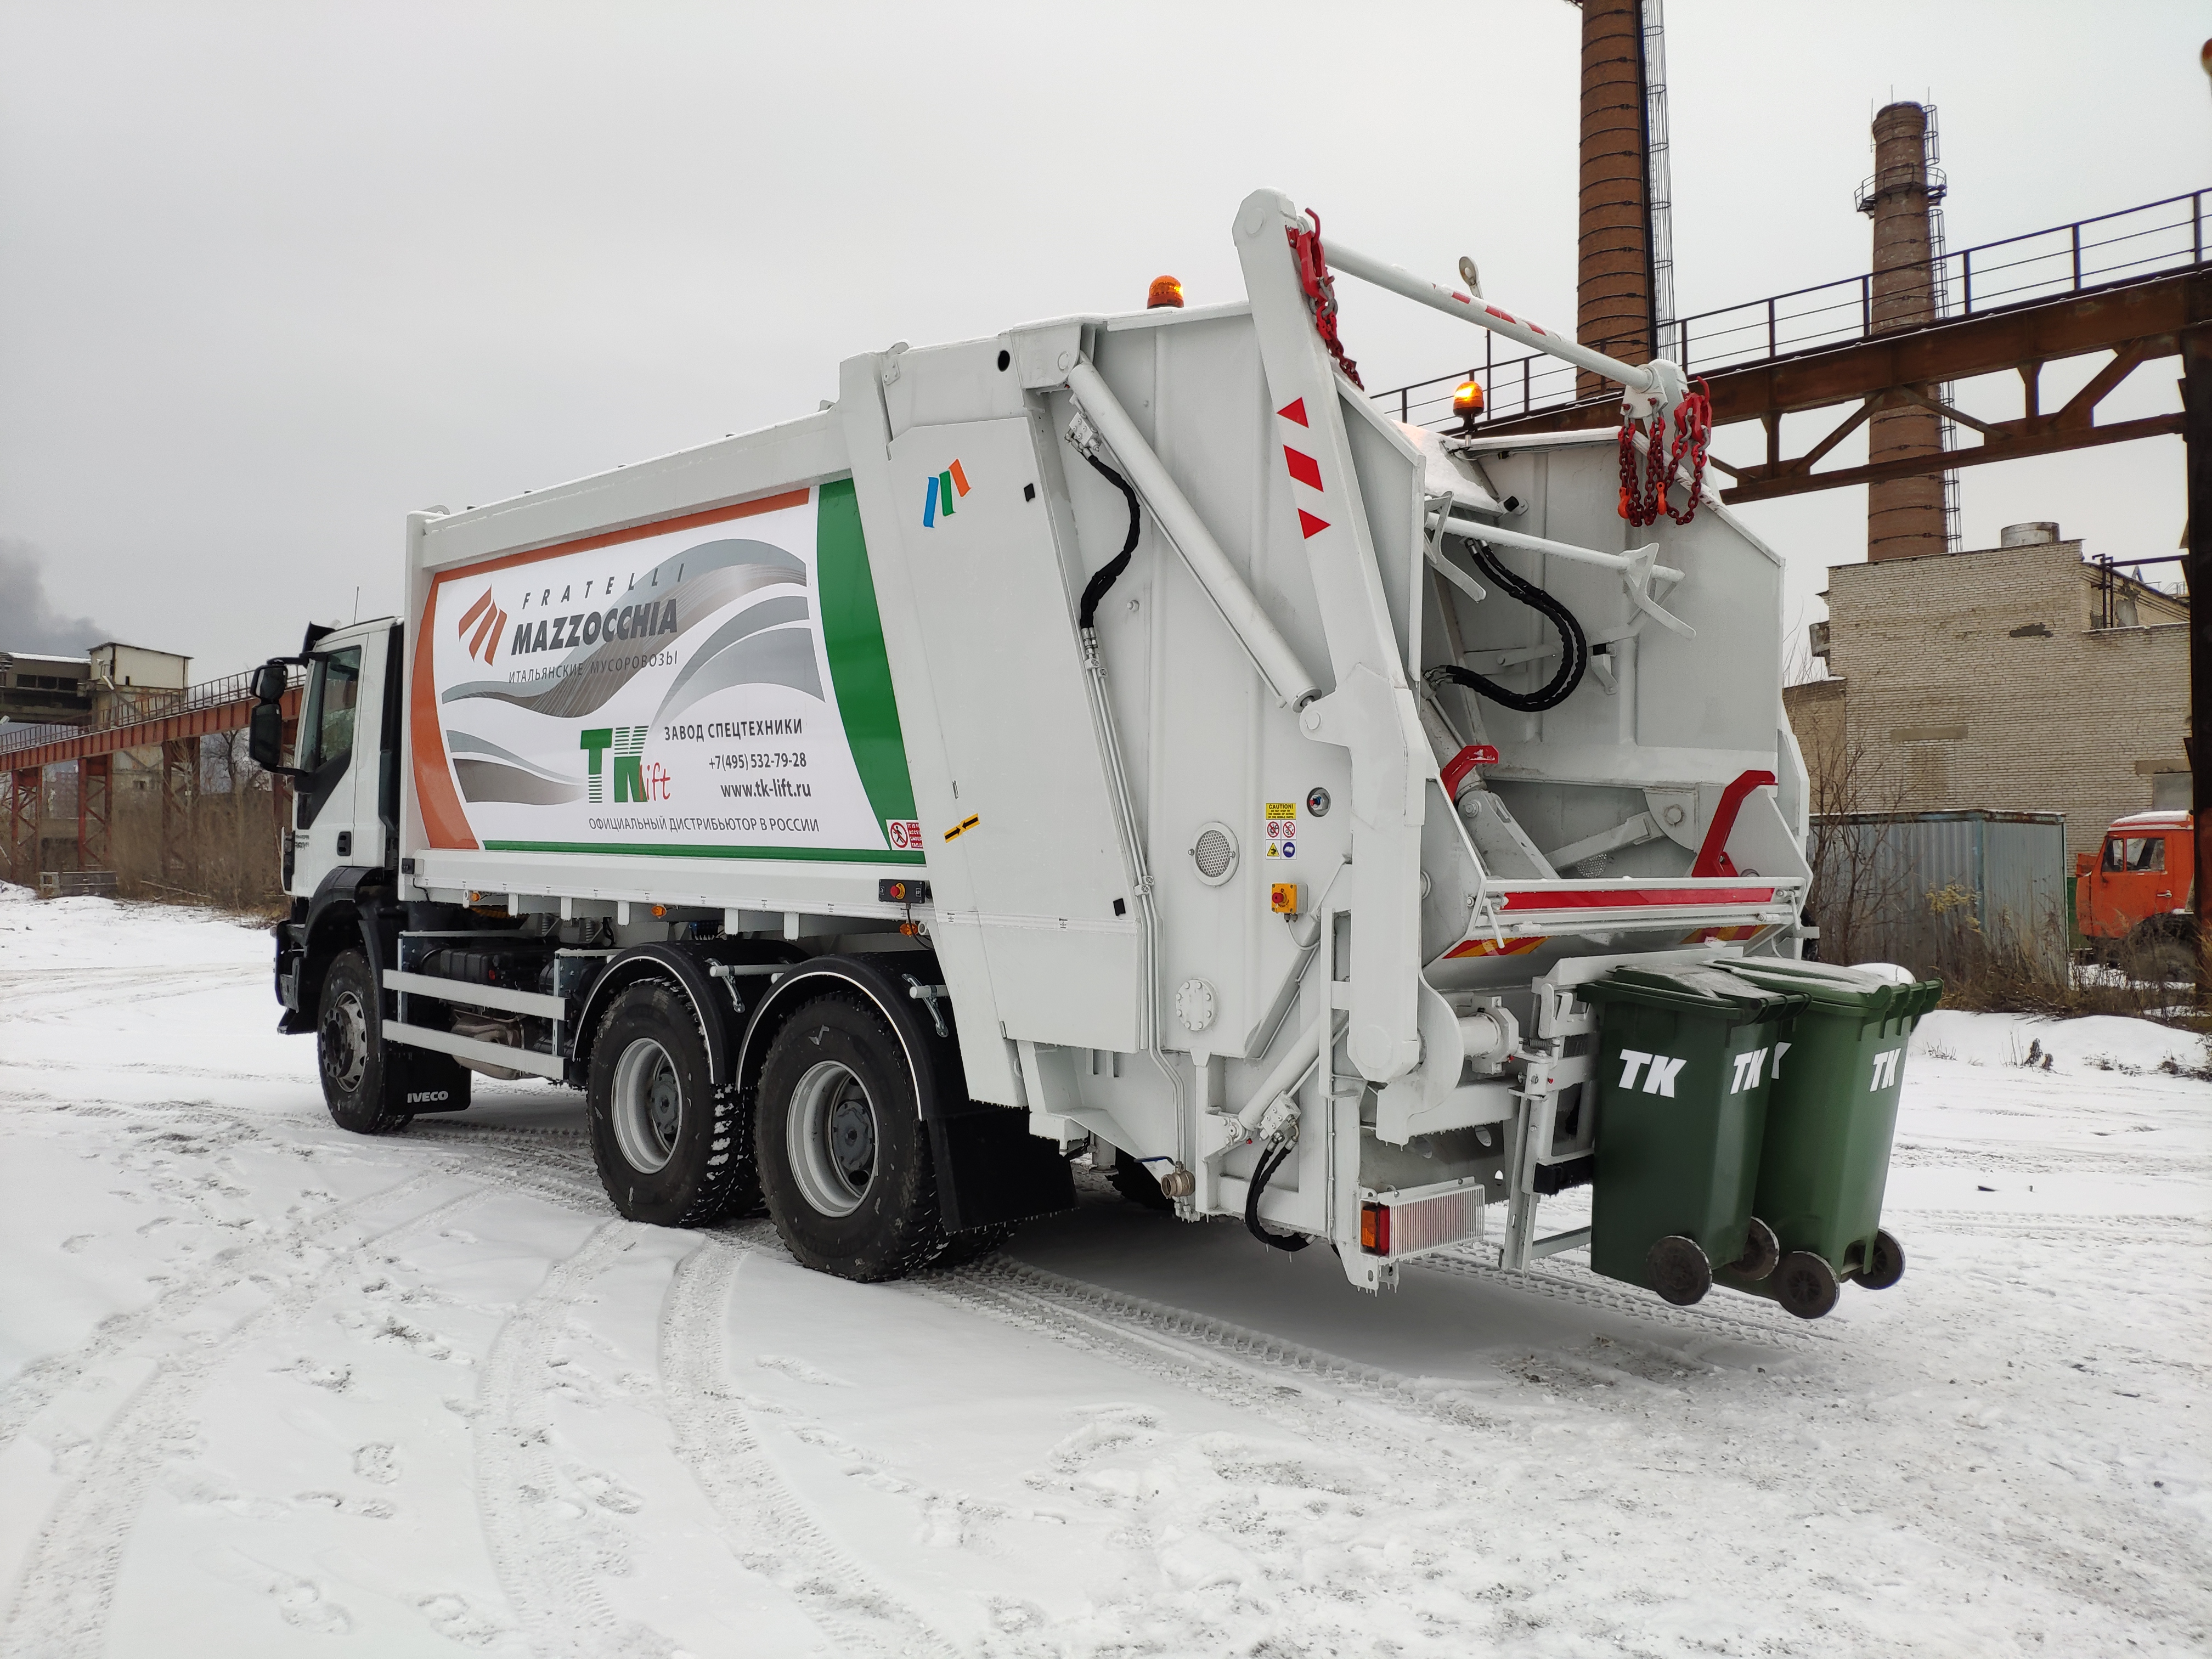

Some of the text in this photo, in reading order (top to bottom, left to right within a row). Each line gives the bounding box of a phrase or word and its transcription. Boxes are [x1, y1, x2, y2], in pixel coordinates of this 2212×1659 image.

[522, 563, 685, 610] FRATELLI
[511, 599, 678, 656] MAZZOCCHIA
[508, 650, 678, 684] ИТАЛЬЯНСКИЕ МУСОРОВОЗЫ
[664, 718, 803, 742] ЗАВОД СПЕЦТЕХНИКИ
[751, 752, 807, 768] 532-79-28
[720, 778, 811, 798] www.tk-lift.ru
[589, 815, 820, 833] ОФИЦИАЛЬНЫЙ ДИСТРИБЬЮТОР В РОССИИ
[407, 1091, 449, 1103] IVECO
